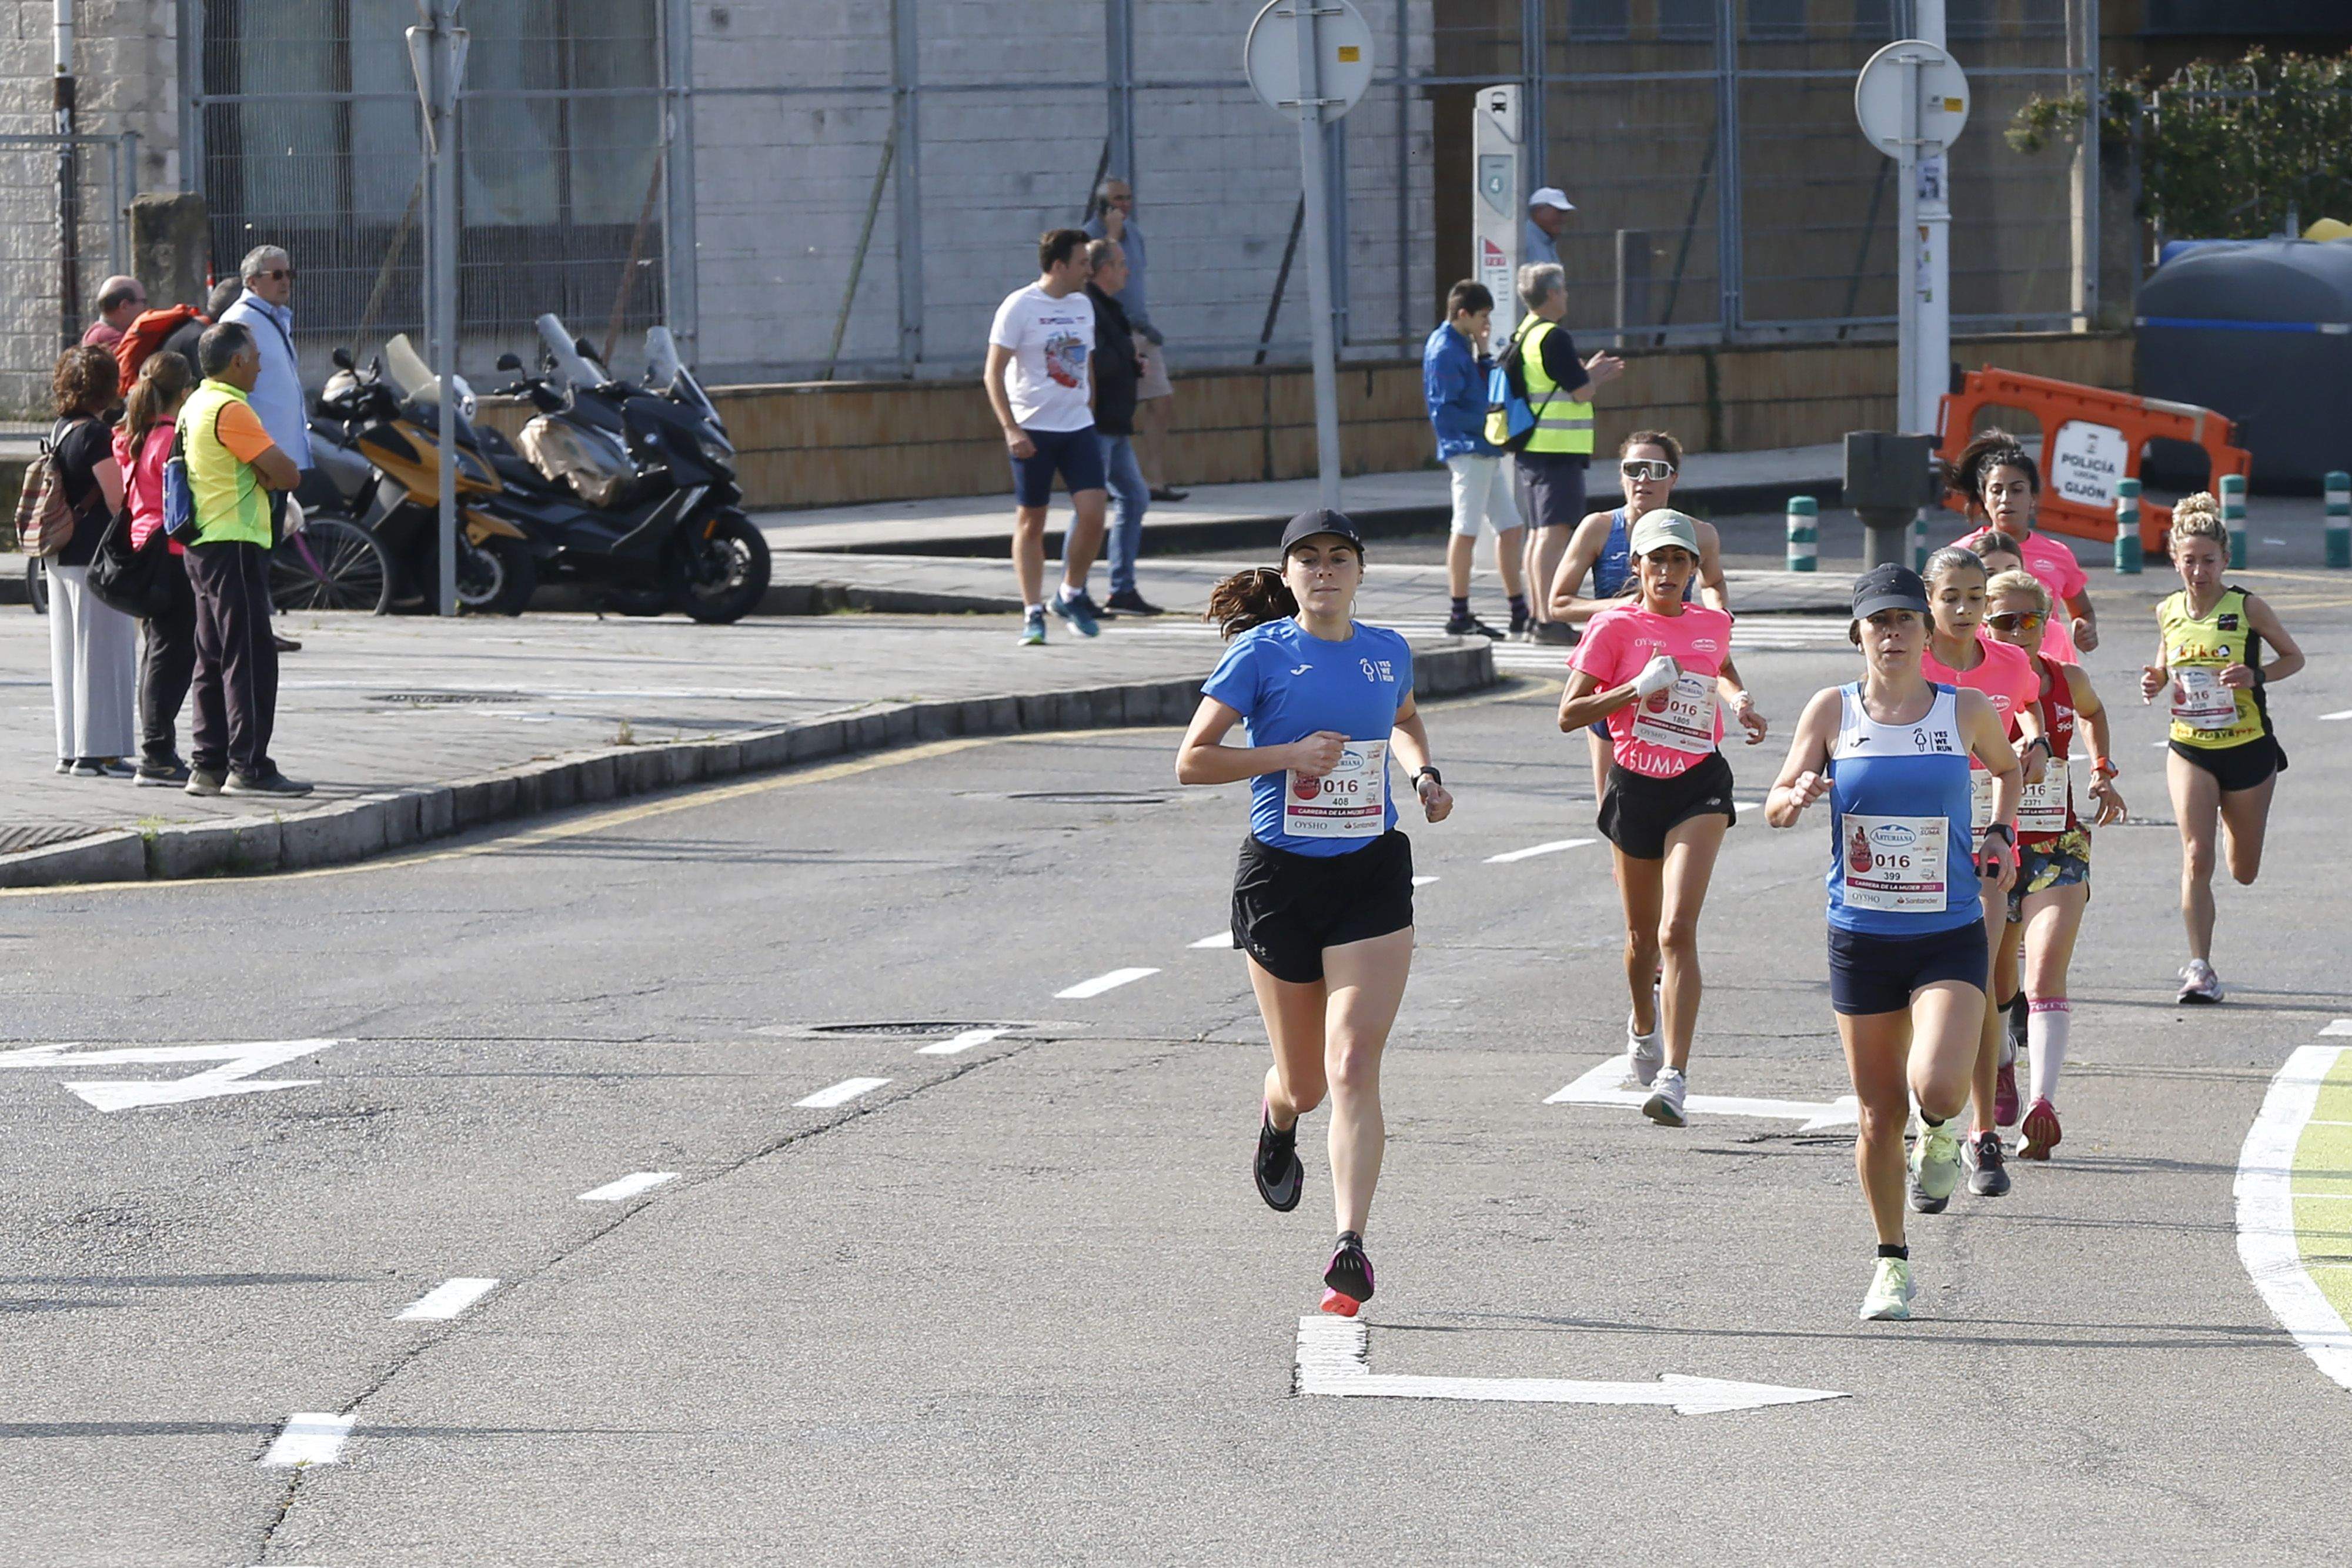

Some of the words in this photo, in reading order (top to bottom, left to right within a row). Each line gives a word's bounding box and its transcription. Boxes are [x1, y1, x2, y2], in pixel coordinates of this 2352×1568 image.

[1671, 701, 1697, 716] 016
[1673, 716, 1690, 725] 1805
[1324, 780, 1358, 793] 016
[1295, 821, 1327, 830] OYSHO
[1876, 854, 1910, 867] 016
[1884, 872, 1900, 880] 399
[1855, 880, 1879, 888] CARRERA
[1852, 892, 1880, 903] OYSHO
